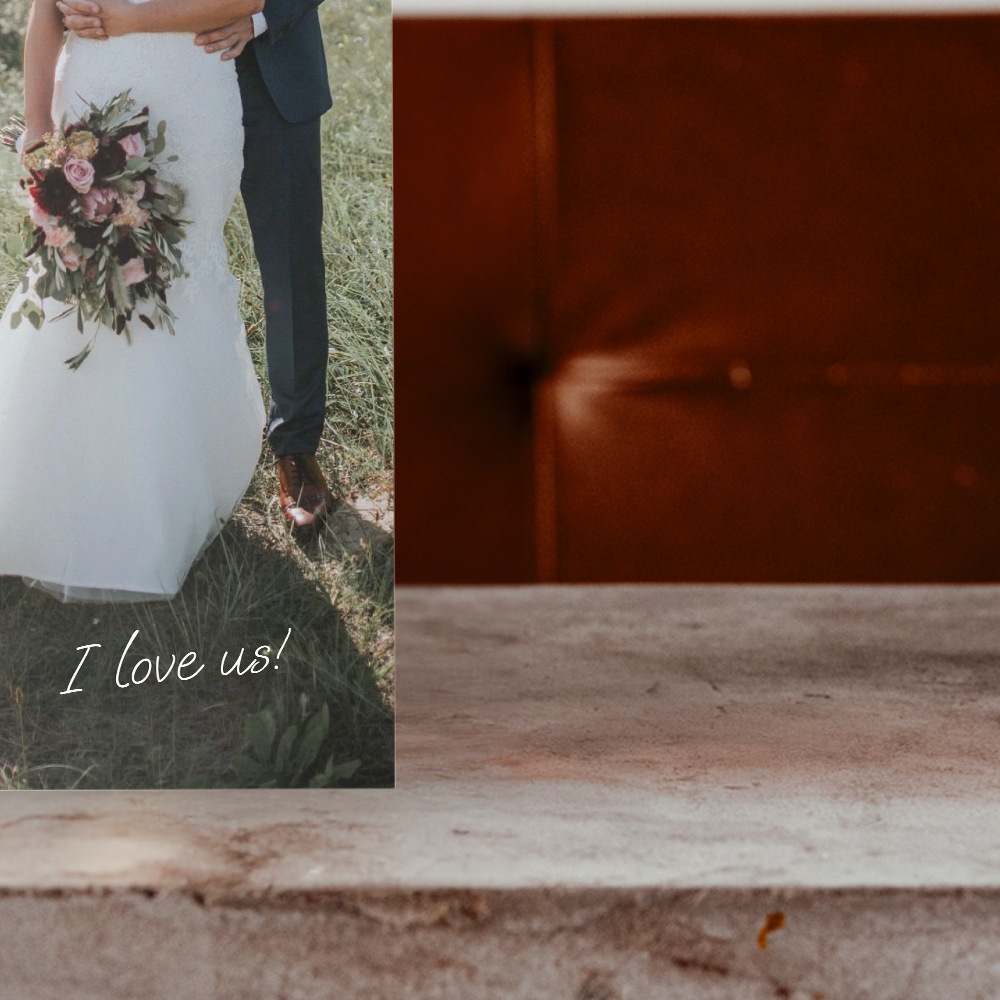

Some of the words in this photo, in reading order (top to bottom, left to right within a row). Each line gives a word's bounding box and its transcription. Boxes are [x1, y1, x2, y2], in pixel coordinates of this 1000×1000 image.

[60, 643, 101, 695] I
[115, 629, 205, 688] love
[220, 627, 292, 676] us!
